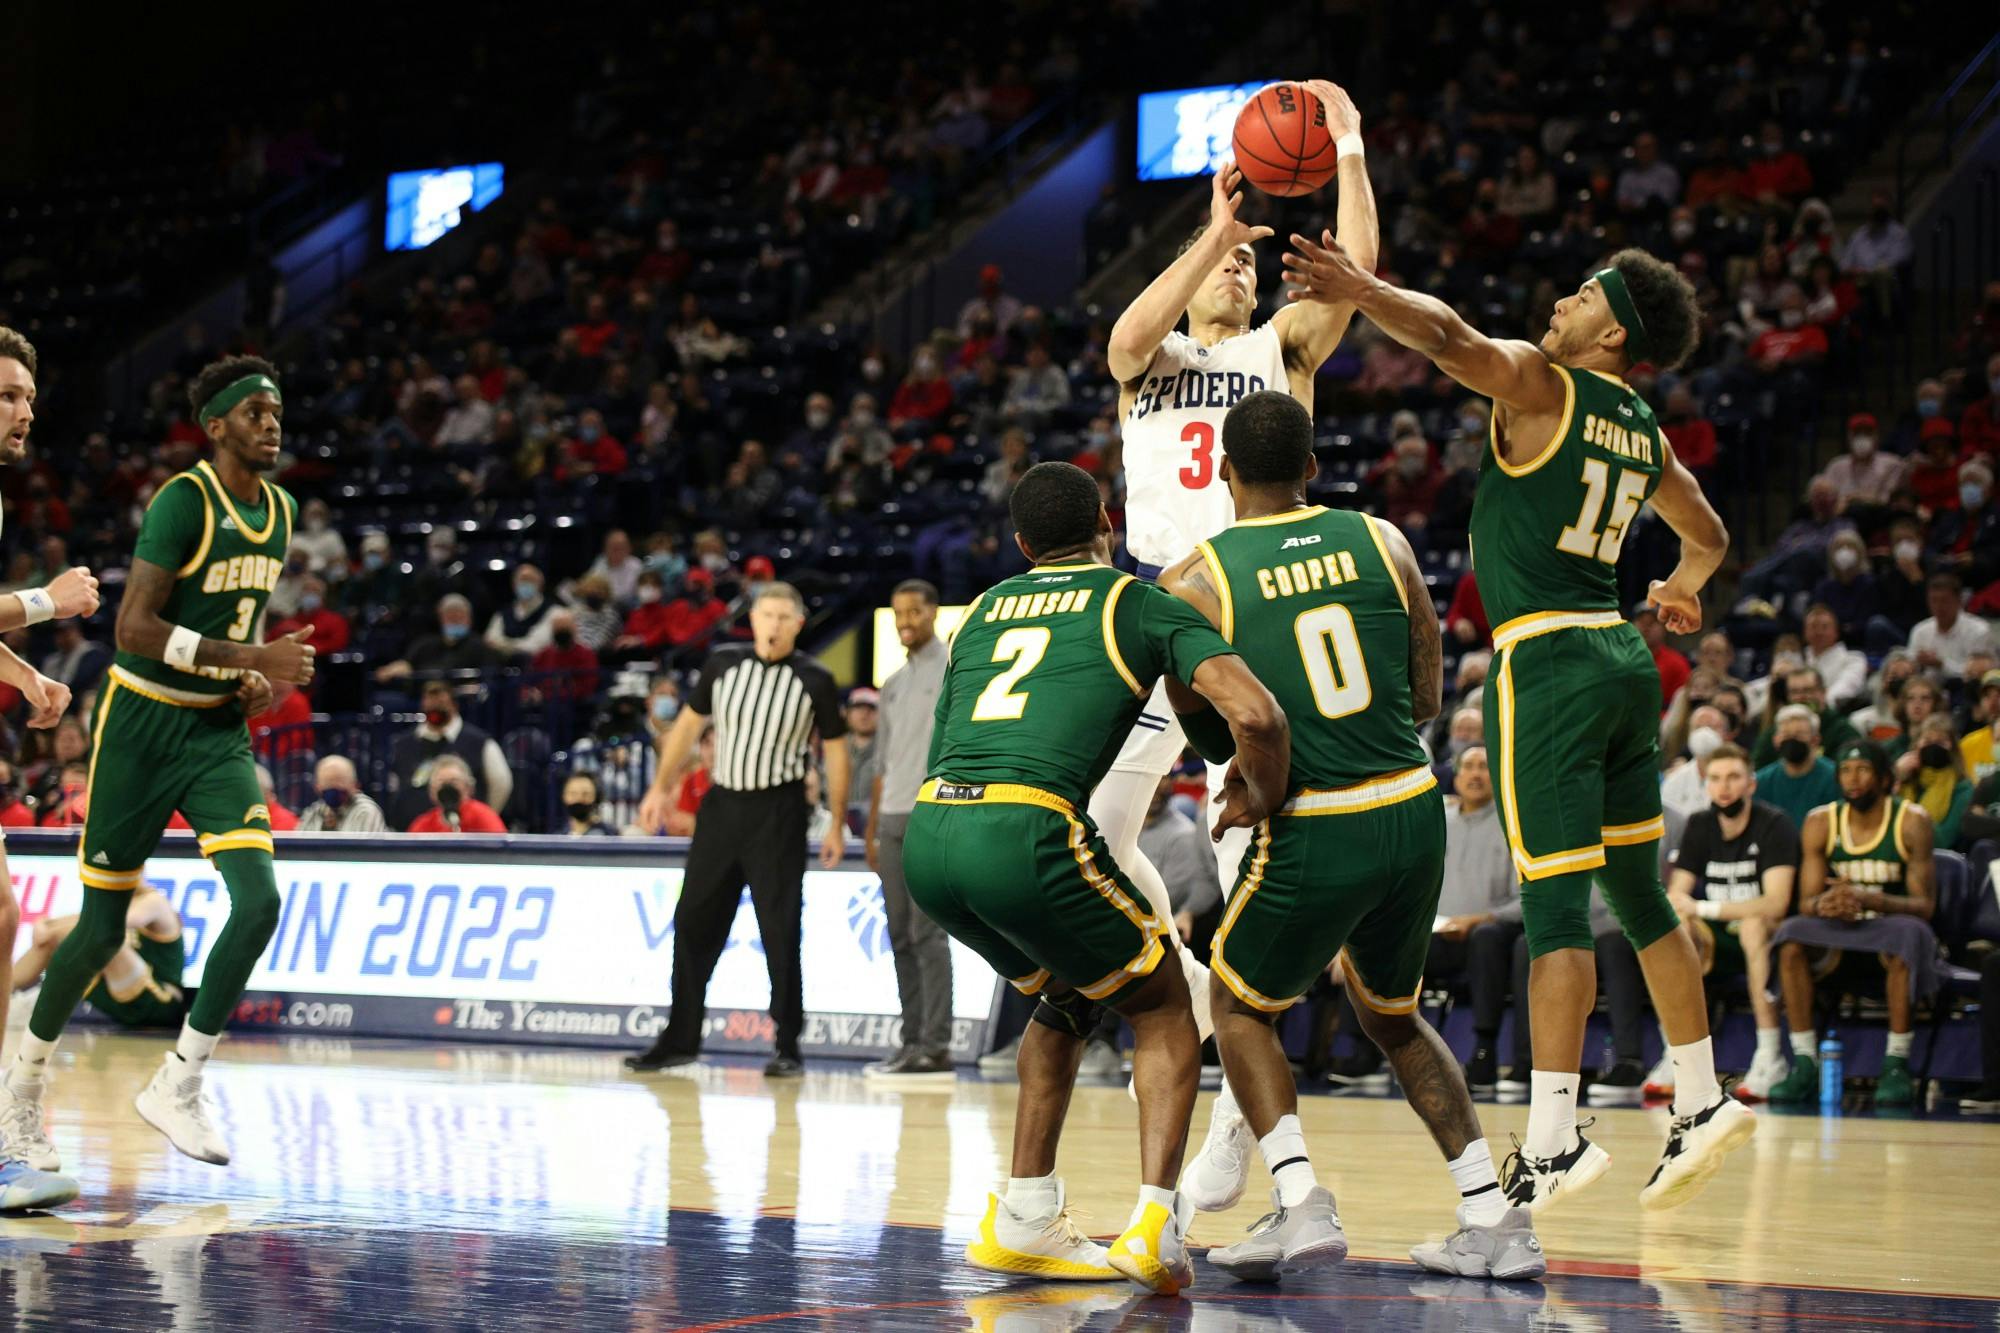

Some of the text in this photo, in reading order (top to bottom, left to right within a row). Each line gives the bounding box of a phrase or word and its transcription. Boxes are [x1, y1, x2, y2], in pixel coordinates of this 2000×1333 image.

[1179, 421, 1215, 490] 3
[1556, 457, 1650, 566] 15
[1280, 534, 1323, 550] A10
[1257, 551, 1361, 600] COOPER
[227, 597, 257, 641] 3
[984, 589, 1093, 623] JOHNSON
[971, 626, 1051, 722] 2
[1294, 603, 1373, 720] 0
[360, 883, 555, 981] 2022
[228, 995, 354, 1028] est.com
[453, 998, 505, 1031] The
[510, 1001, 624, 1037] Yeatman
